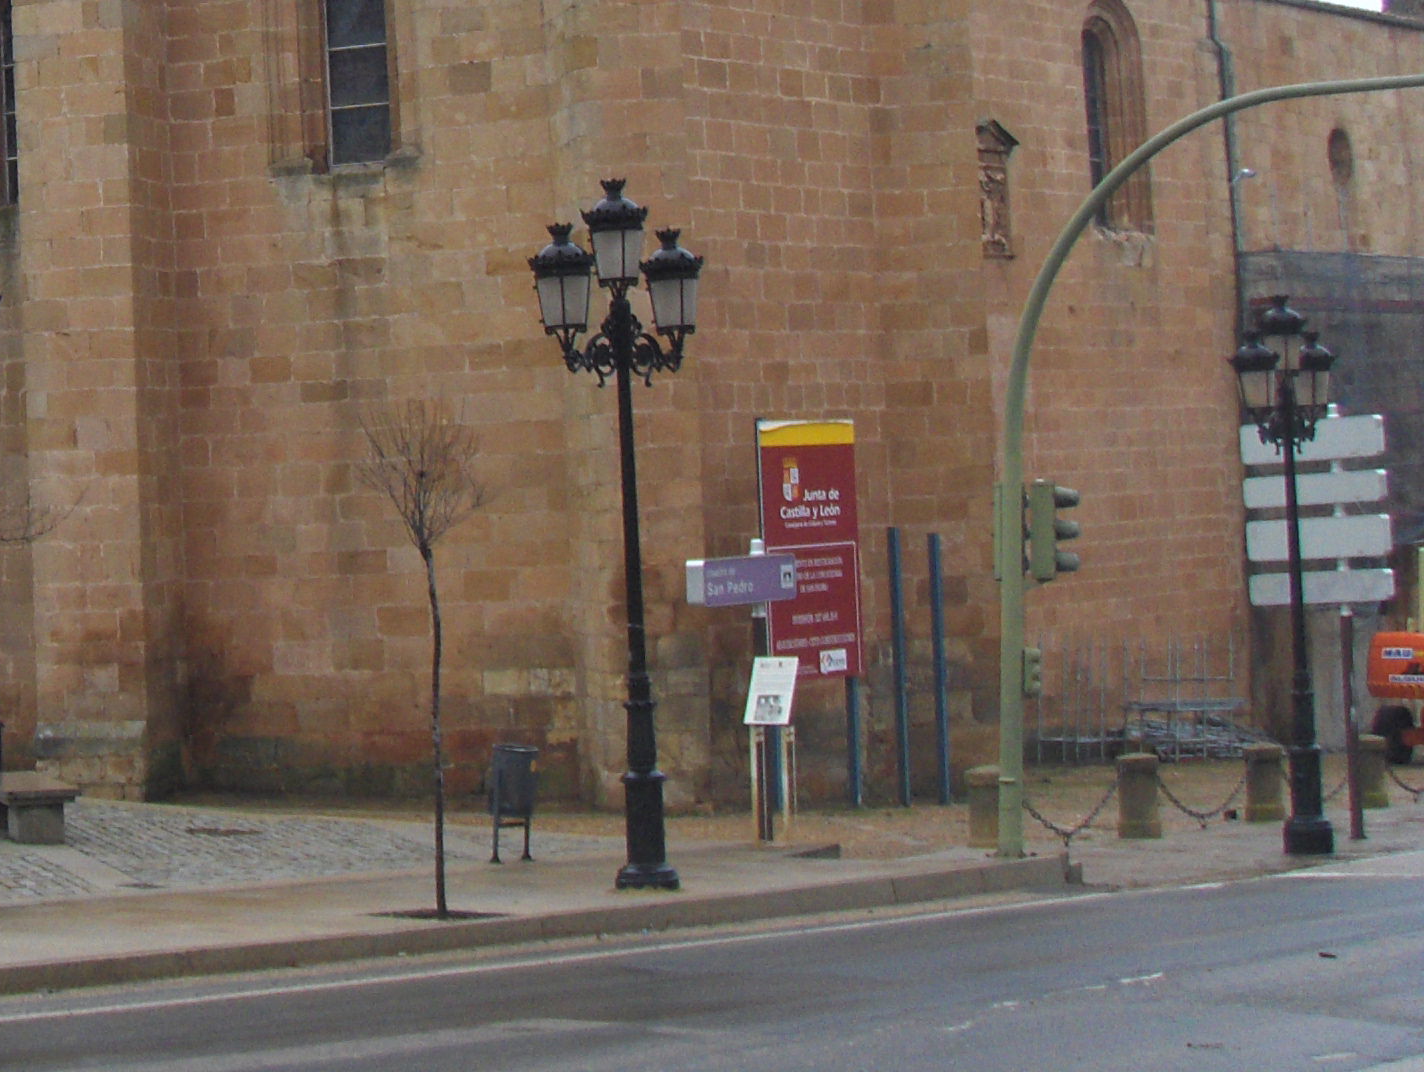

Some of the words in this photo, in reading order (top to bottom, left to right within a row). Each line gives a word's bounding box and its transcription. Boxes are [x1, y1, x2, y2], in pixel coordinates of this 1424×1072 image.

[802, 489, 827, 502] Junta
[828, 488, 840, 501] de
[780, 505, 811, 520] Castilla
[812, 507, 818, 520] y
[819, 503, 841, 517] León
[707, 581, 724, 597] San
[726, 579, 754, 595] Pedro
